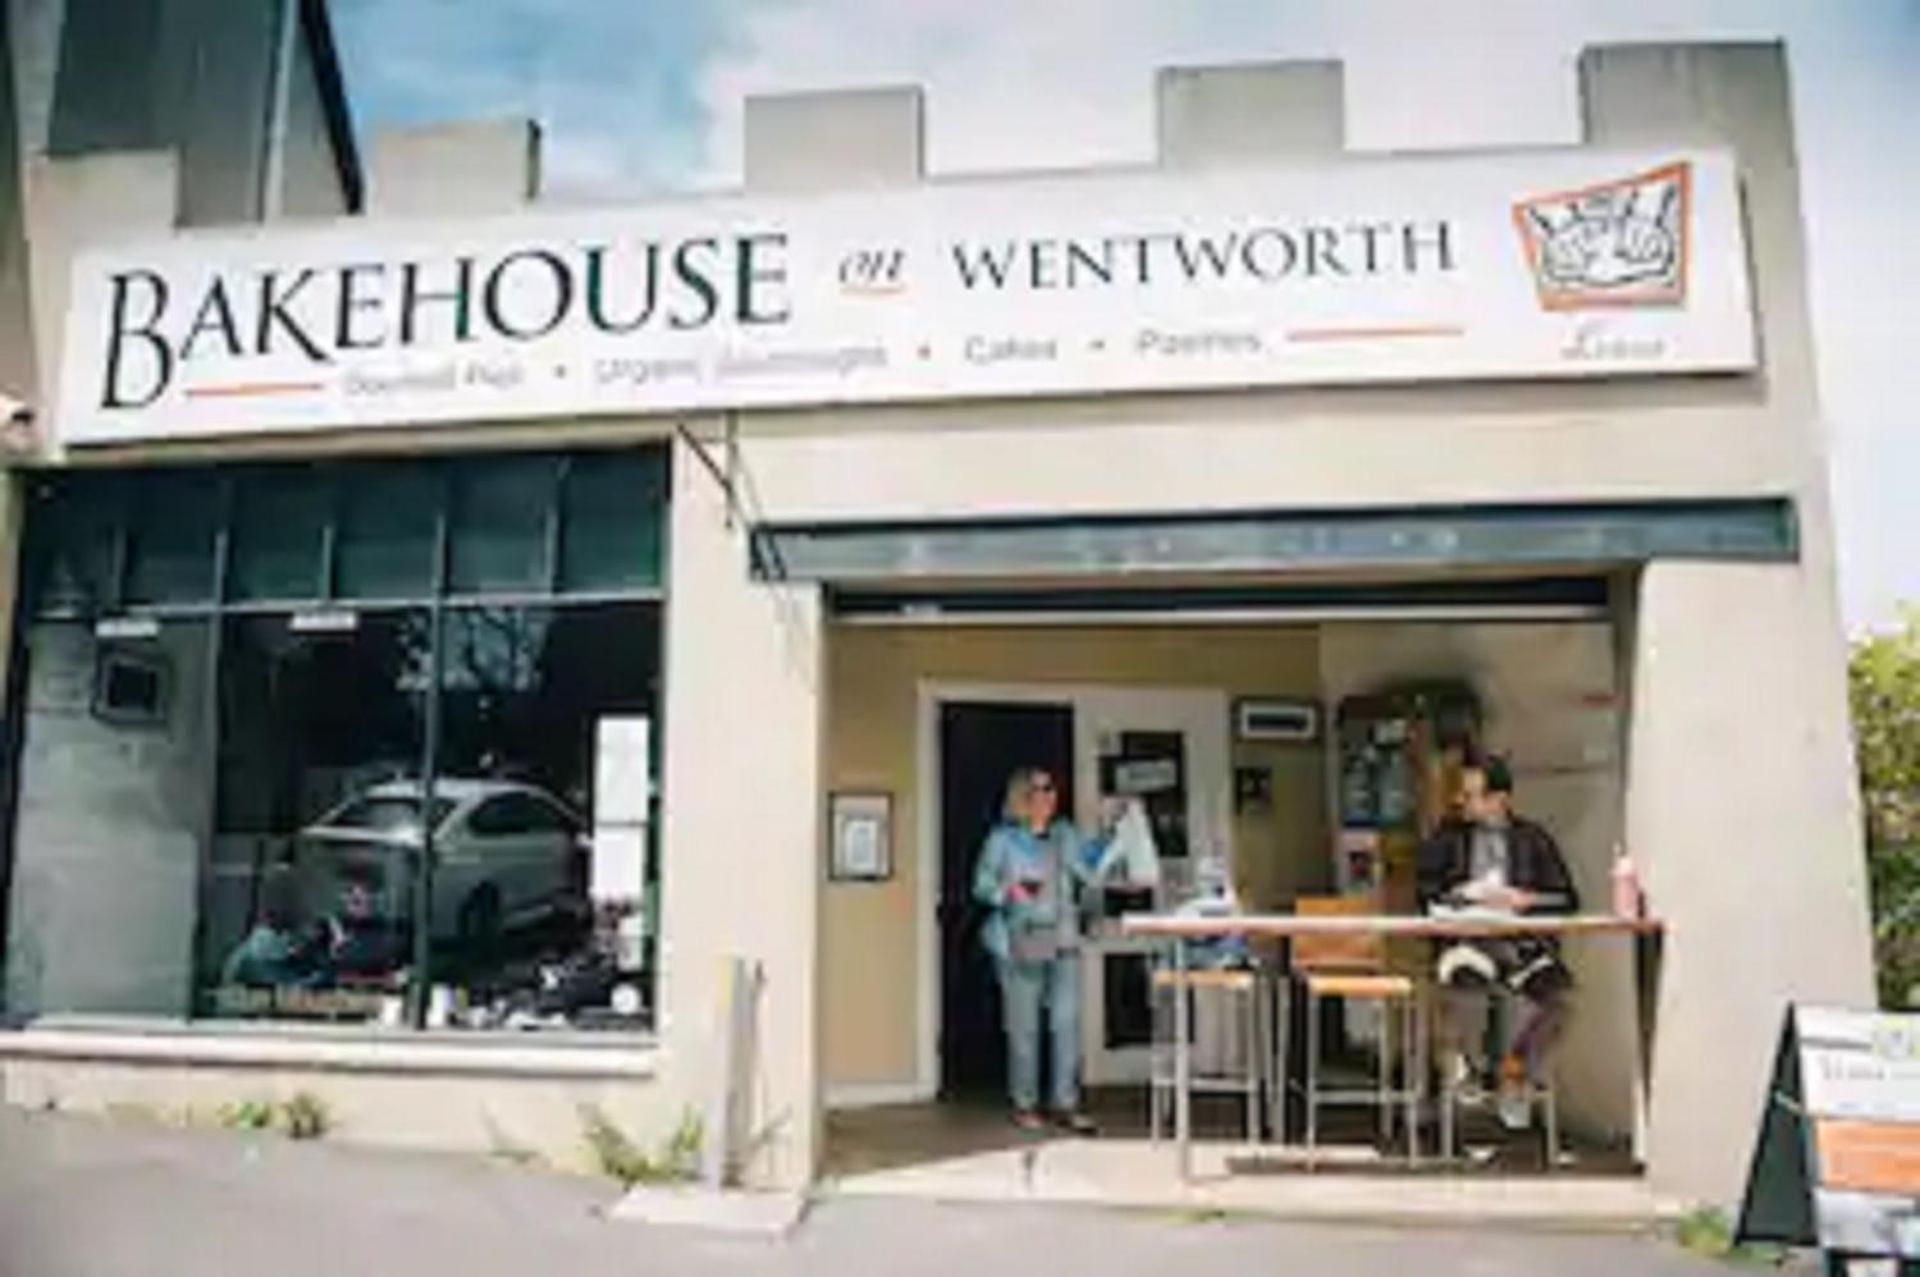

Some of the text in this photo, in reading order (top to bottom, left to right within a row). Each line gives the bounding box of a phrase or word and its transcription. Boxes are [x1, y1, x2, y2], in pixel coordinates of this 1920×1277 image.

[101, 232, 790, 410] BAKEHOUSE
[838, 249, 904, 284] on
[952, 220, 1456, 290] WENTWORTH
